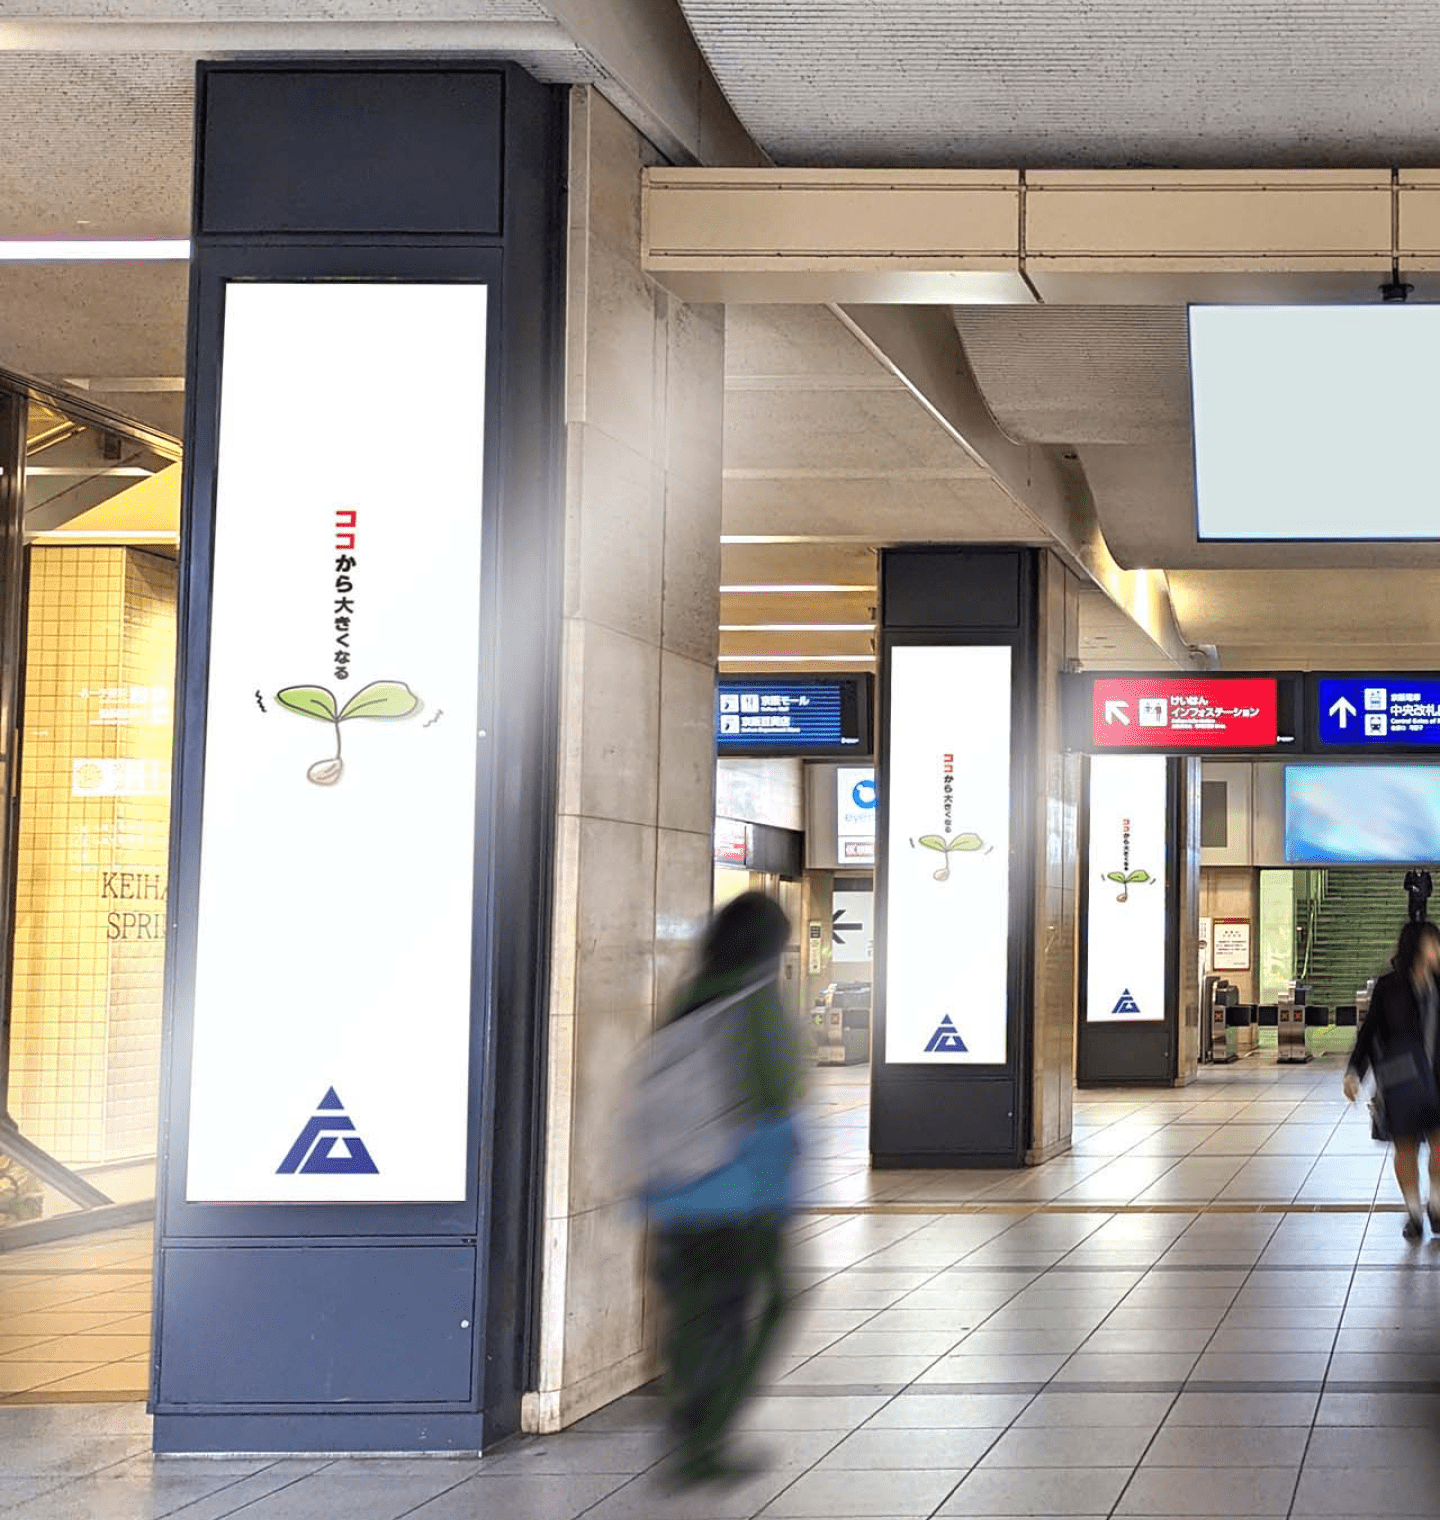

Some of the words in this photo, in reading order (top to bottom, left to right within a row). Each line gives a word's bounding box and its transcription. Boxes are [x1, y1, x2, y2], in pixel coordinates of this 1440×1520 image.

[334, 510, 357, 680] ココから大きくなる
[1171, 707, 1260, 718] インフォステーション
